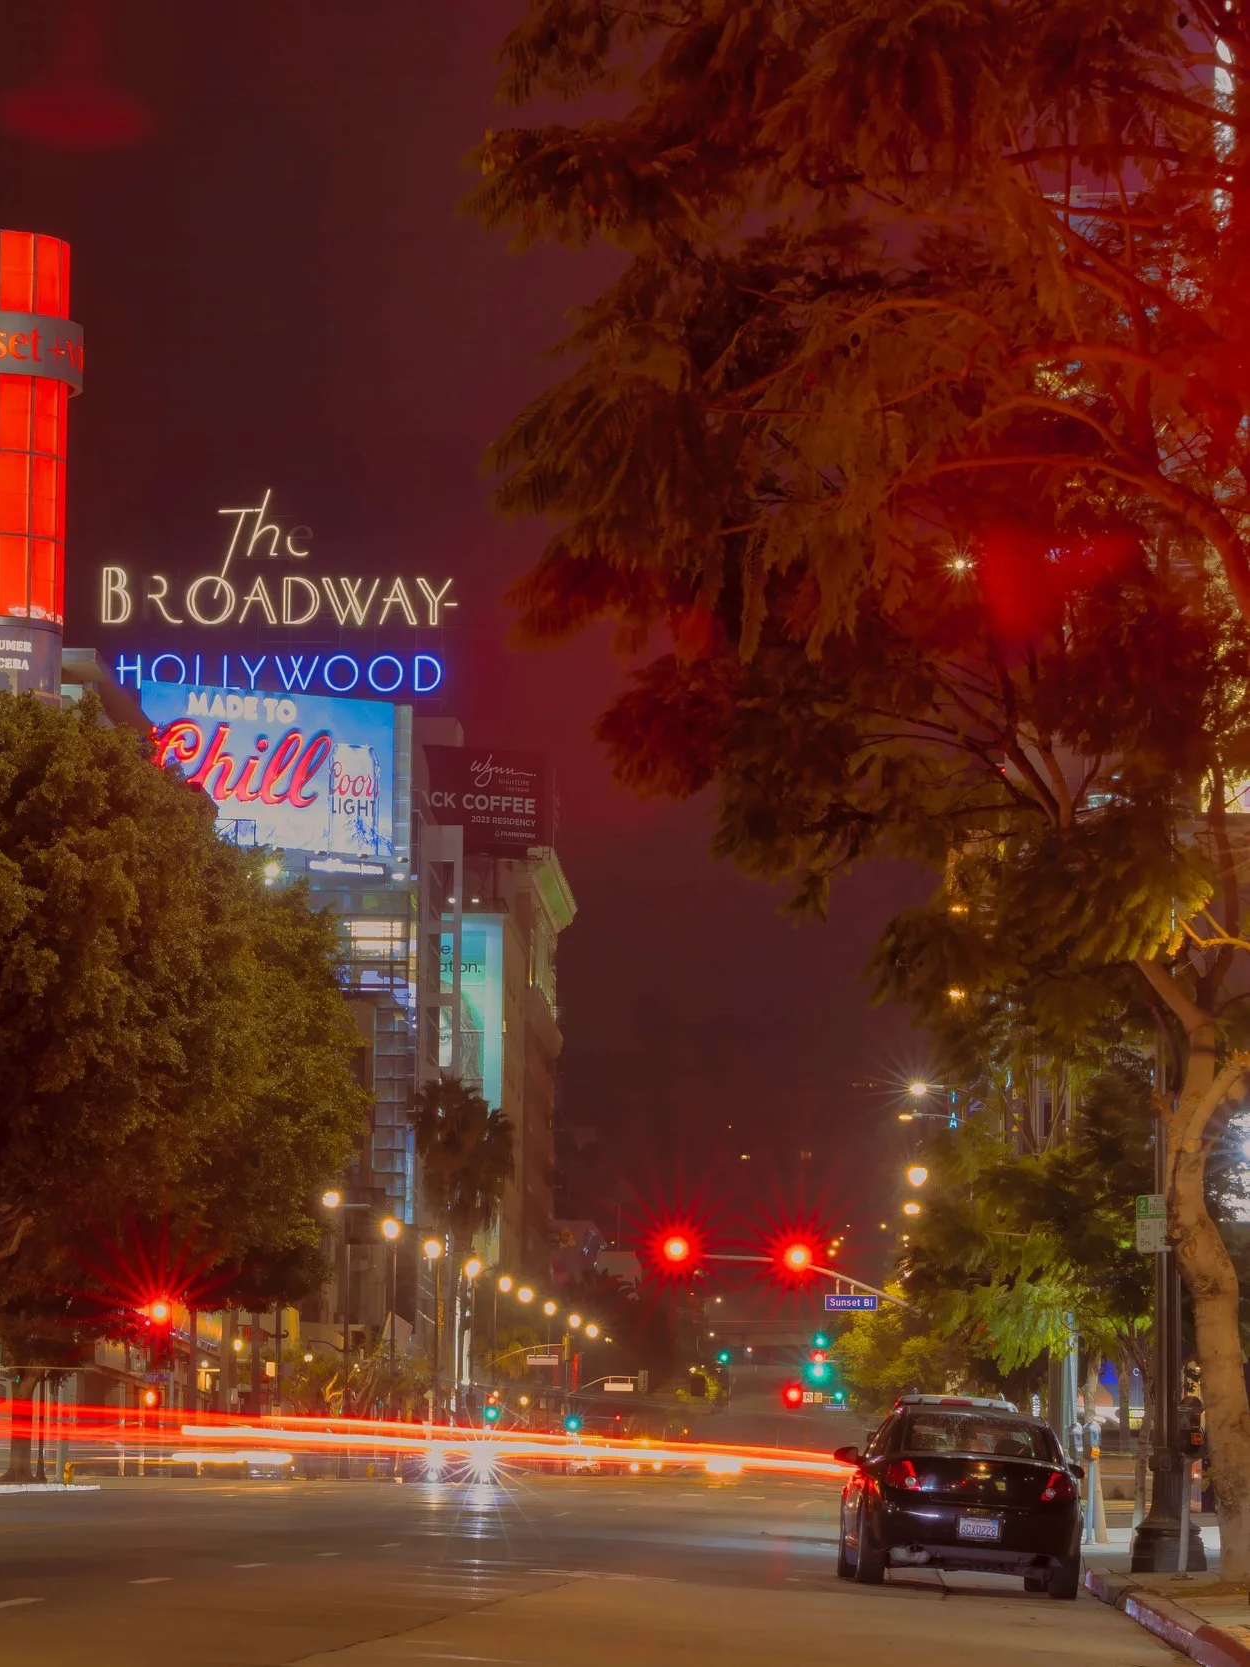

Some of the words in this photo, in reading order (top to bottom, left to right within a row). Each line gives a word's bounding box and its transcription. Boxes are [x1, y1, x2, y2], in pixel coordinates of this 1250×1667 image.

[217, 488, 314, 599] The
[116, 653, 442, 692] HOLLYWOOD
[186, 691, 258, 722] MADE
[262, 698, 298, 724] TO
[151, 717, 332, 809] Chill
[331, 796, 376, 817] LIGHT
[462, 793, 536, 815] COFFEE
[470, 815, 490, 824] 2023
[491, 816, 536, 828] RESIDENCY
[499, 831, 536, 839] FRAMEWORK
[829, 1298, 861, 1307] Sunset
[863, 1298, 874, 1307] Bl
